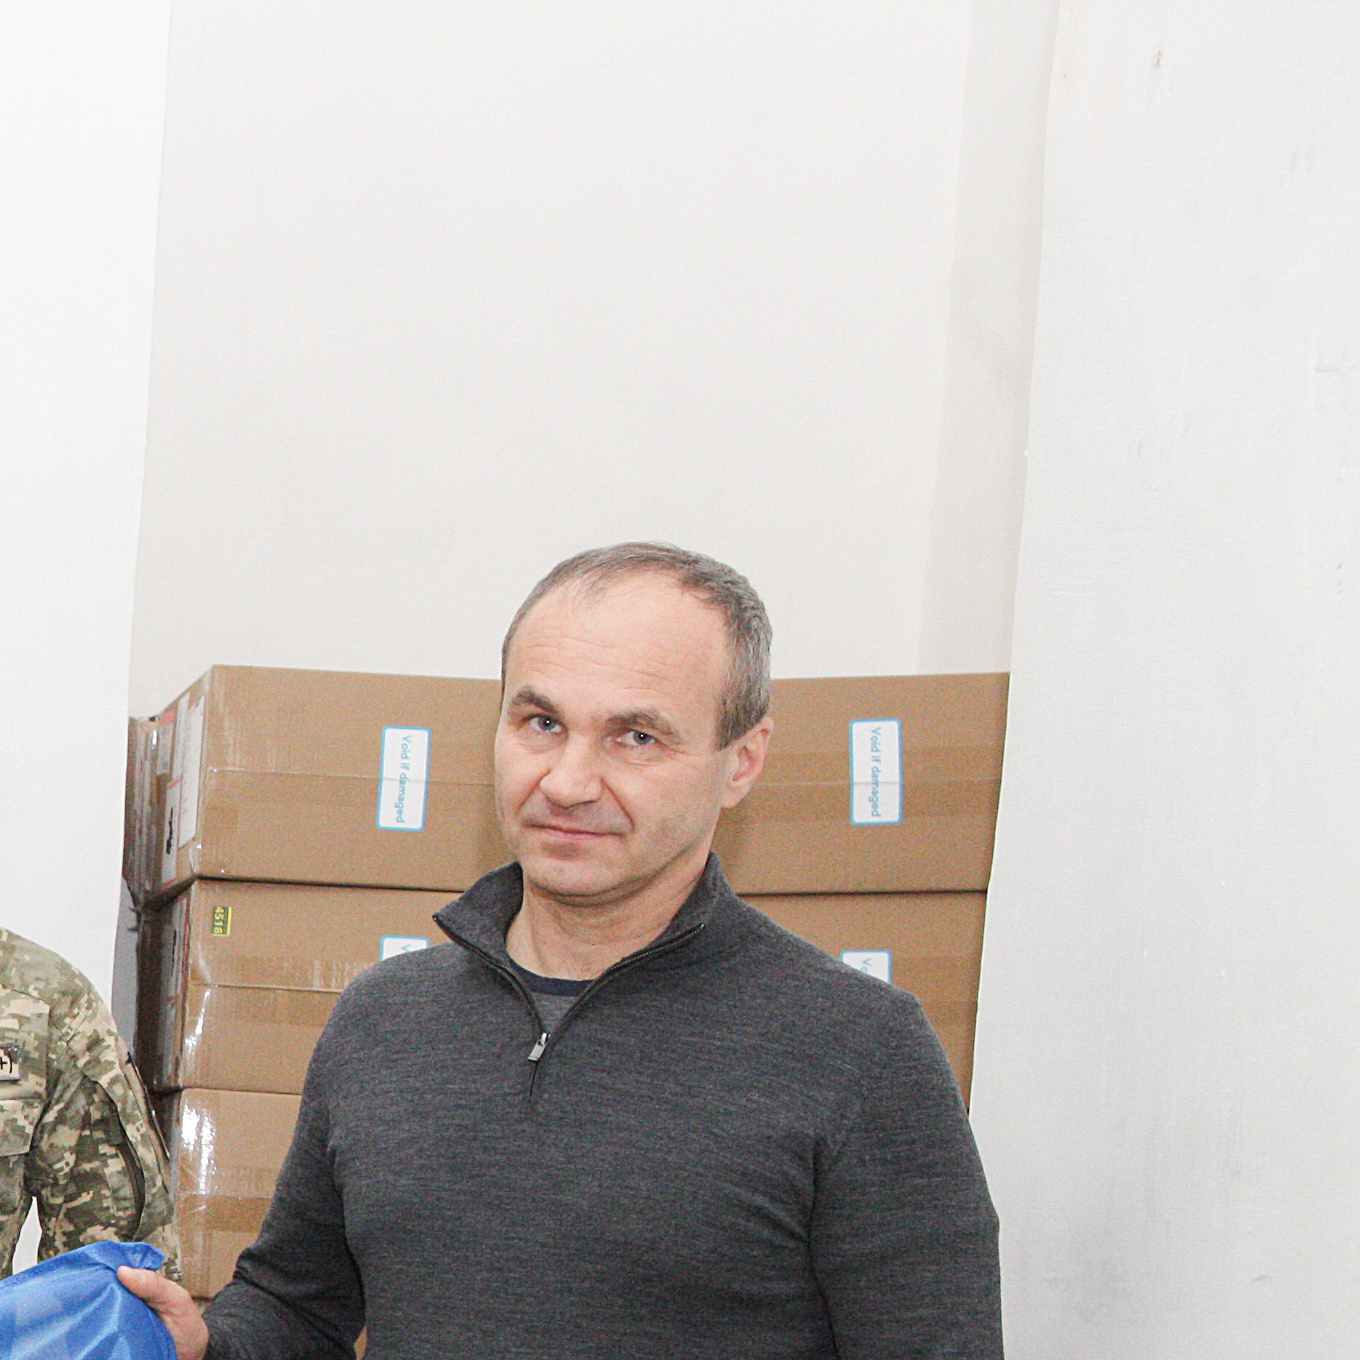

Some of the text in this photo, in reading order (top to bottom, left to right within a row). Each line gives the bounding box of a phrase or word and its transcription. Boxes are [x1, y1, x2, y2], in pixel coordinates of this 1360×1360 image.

[395, 735, 412, 823] Void if damaged
[869, 727, 881, 817] Void if damaged
